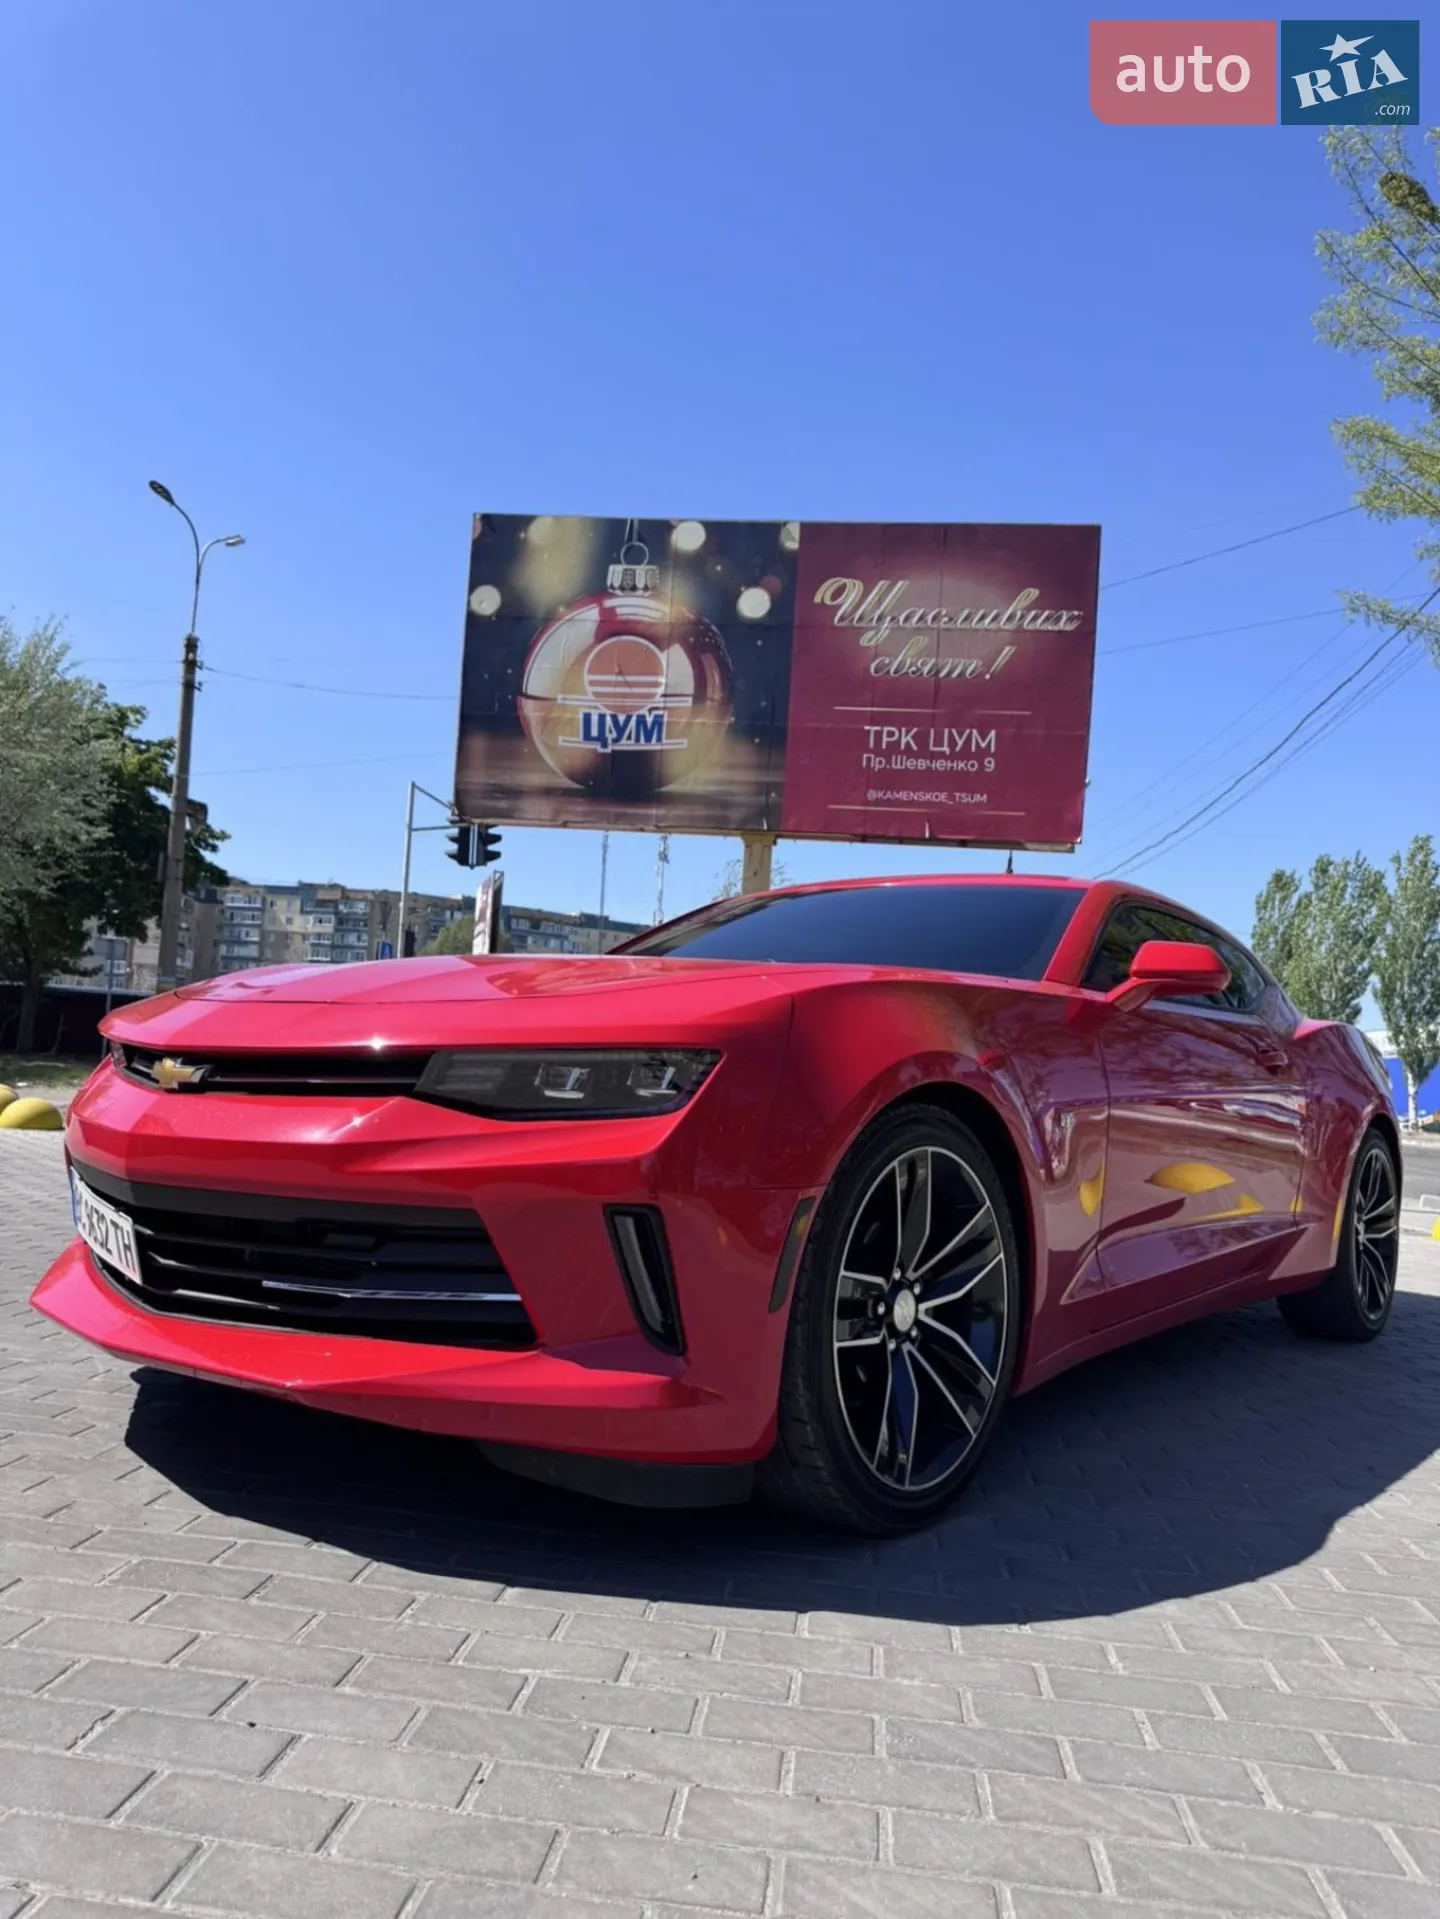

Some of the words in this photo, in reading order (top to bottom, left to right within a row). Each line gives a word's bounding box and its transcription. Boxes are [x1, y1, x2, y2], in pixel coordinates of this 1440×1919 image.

[813, 577, 1084, 647] Щасливих
[869, 635, 1017, 680] свят!
[581, 711, 667, 751] ЦУМ
[863, 725, 919, 751] ТРК
[928, 727, 997, 756] ЦУМ
[861, 753, 979, 773] Пр.Шевченко
[983, 756, 996, 773] 9
[865, 788, 988, 805] @KAMENSKOE_TSUM
[109, 1217, 137, 1275] TH
